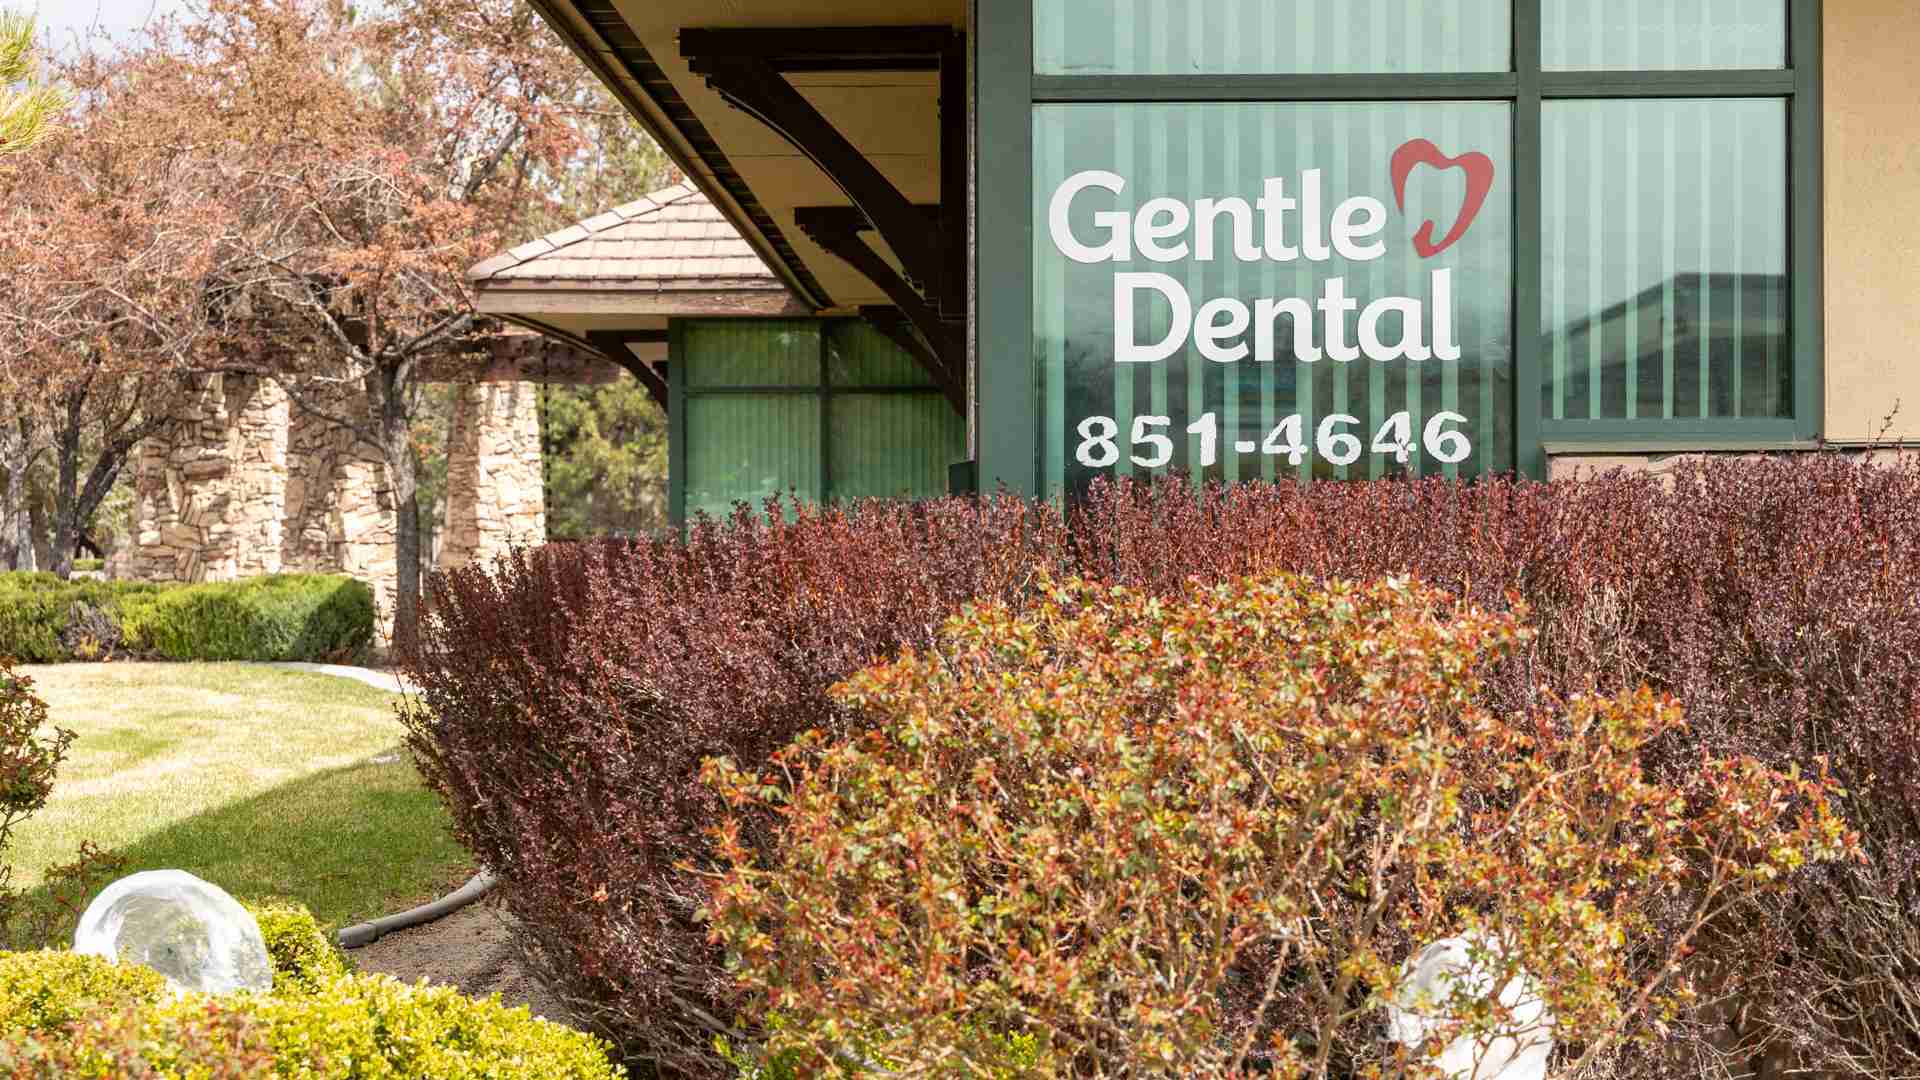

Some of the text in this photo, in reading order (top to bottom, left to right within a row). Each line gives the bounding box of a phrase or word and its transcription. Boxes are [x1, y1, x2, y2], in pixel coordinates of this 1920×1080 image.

[1048, 168, 1387, 264] Gentle
[1113, 268, 1462, 363] Dental
[1075, 411, 1471, 468] 851-4646
